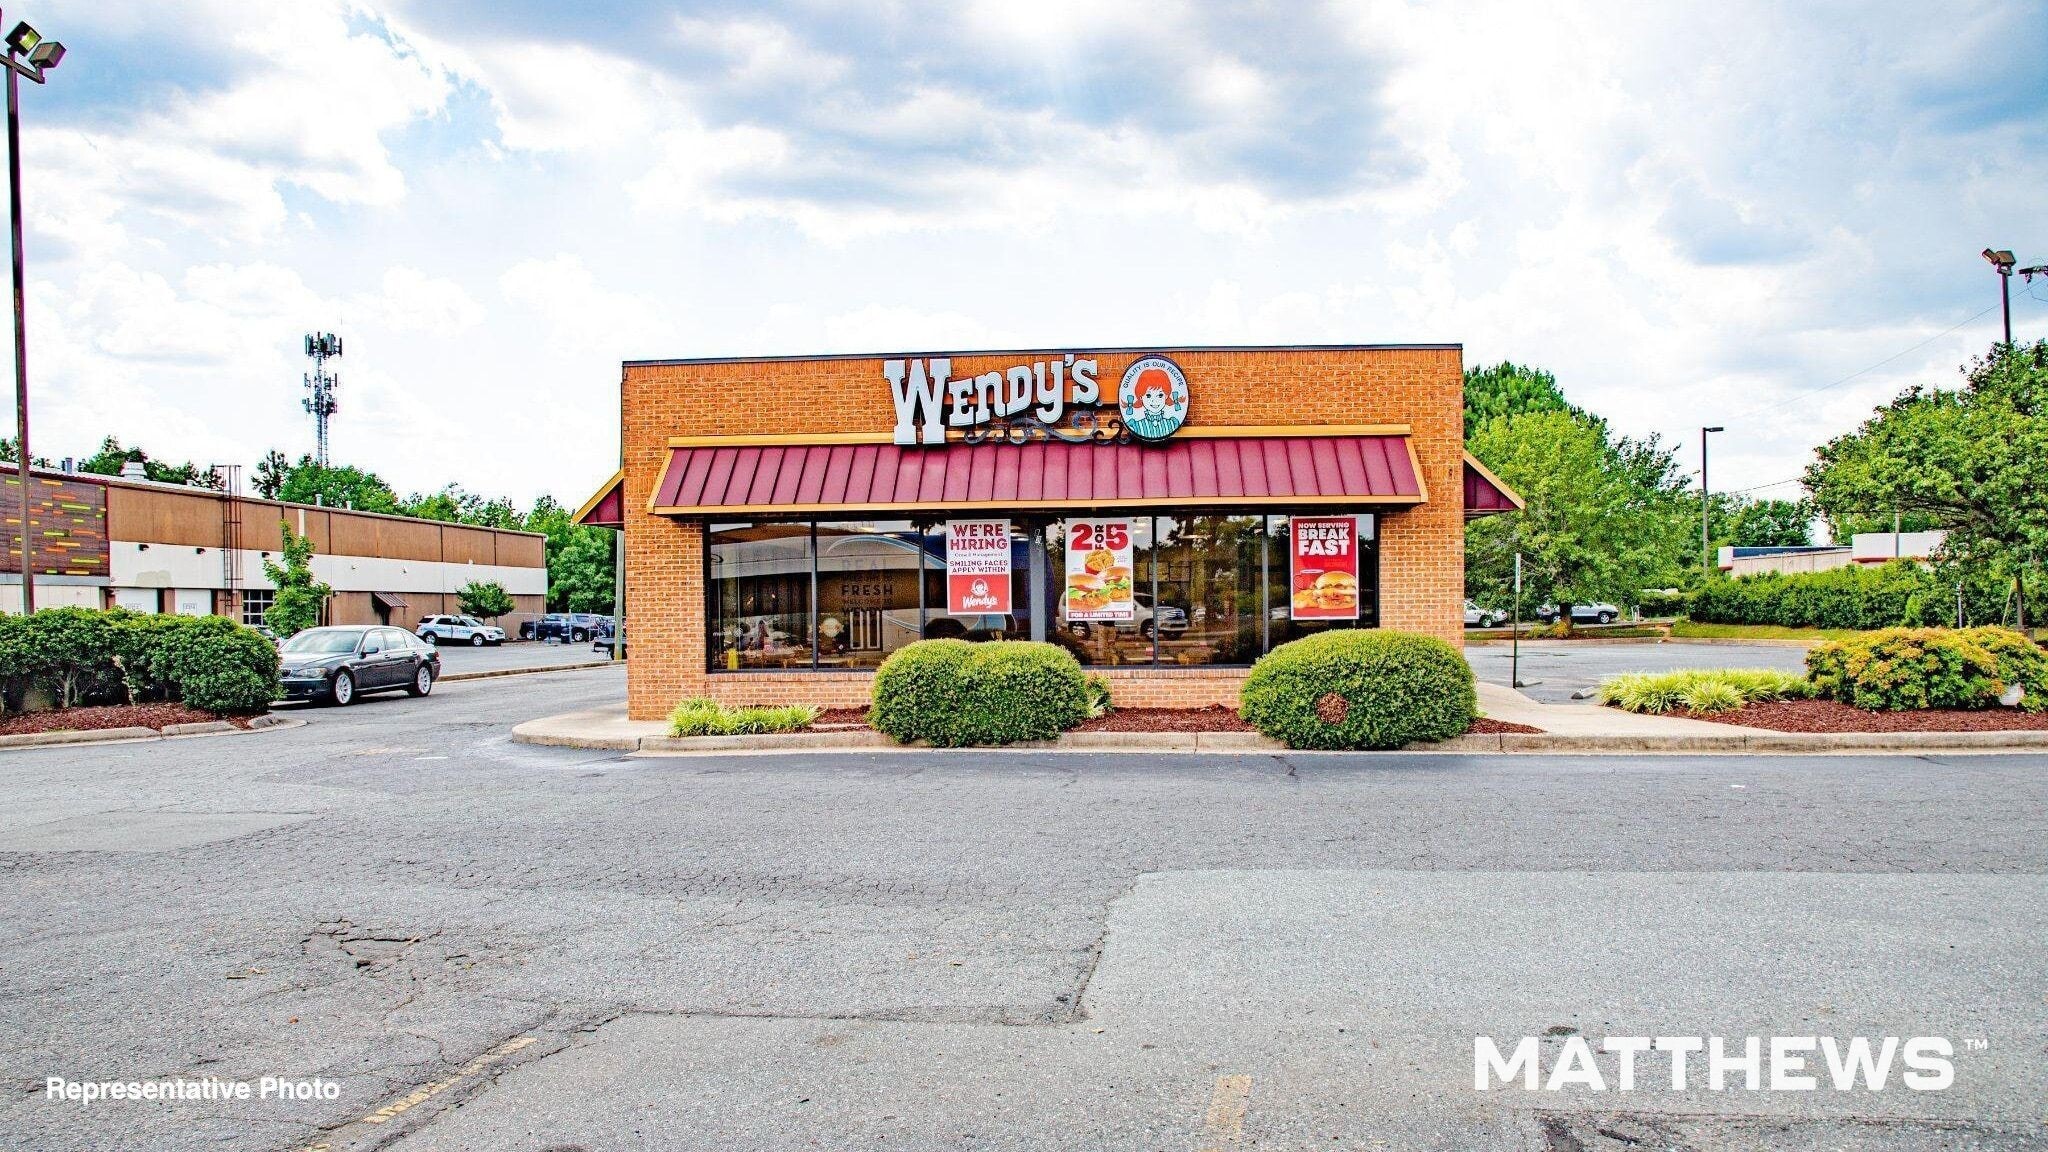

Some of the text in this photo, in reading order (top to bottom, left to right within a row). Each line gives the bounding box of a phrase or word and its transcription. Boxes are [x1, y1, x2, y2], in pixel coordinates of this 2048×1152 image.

[1123, 366, 1141, 388] QUALITY
[1166, 366, 1184, 386] RECIPE
[952, 524, 1003, 537] WE'RE
[1071, 524, 1092, 550] 2
[1095, 525, 1104, 550] FOR
[1298, 528, 1350, 540] BREAK
[950, 538, 1008, 550] HIRING
[1298, 540, 1350, 555] FAST
[841, 585, 893, 596] FRESH
